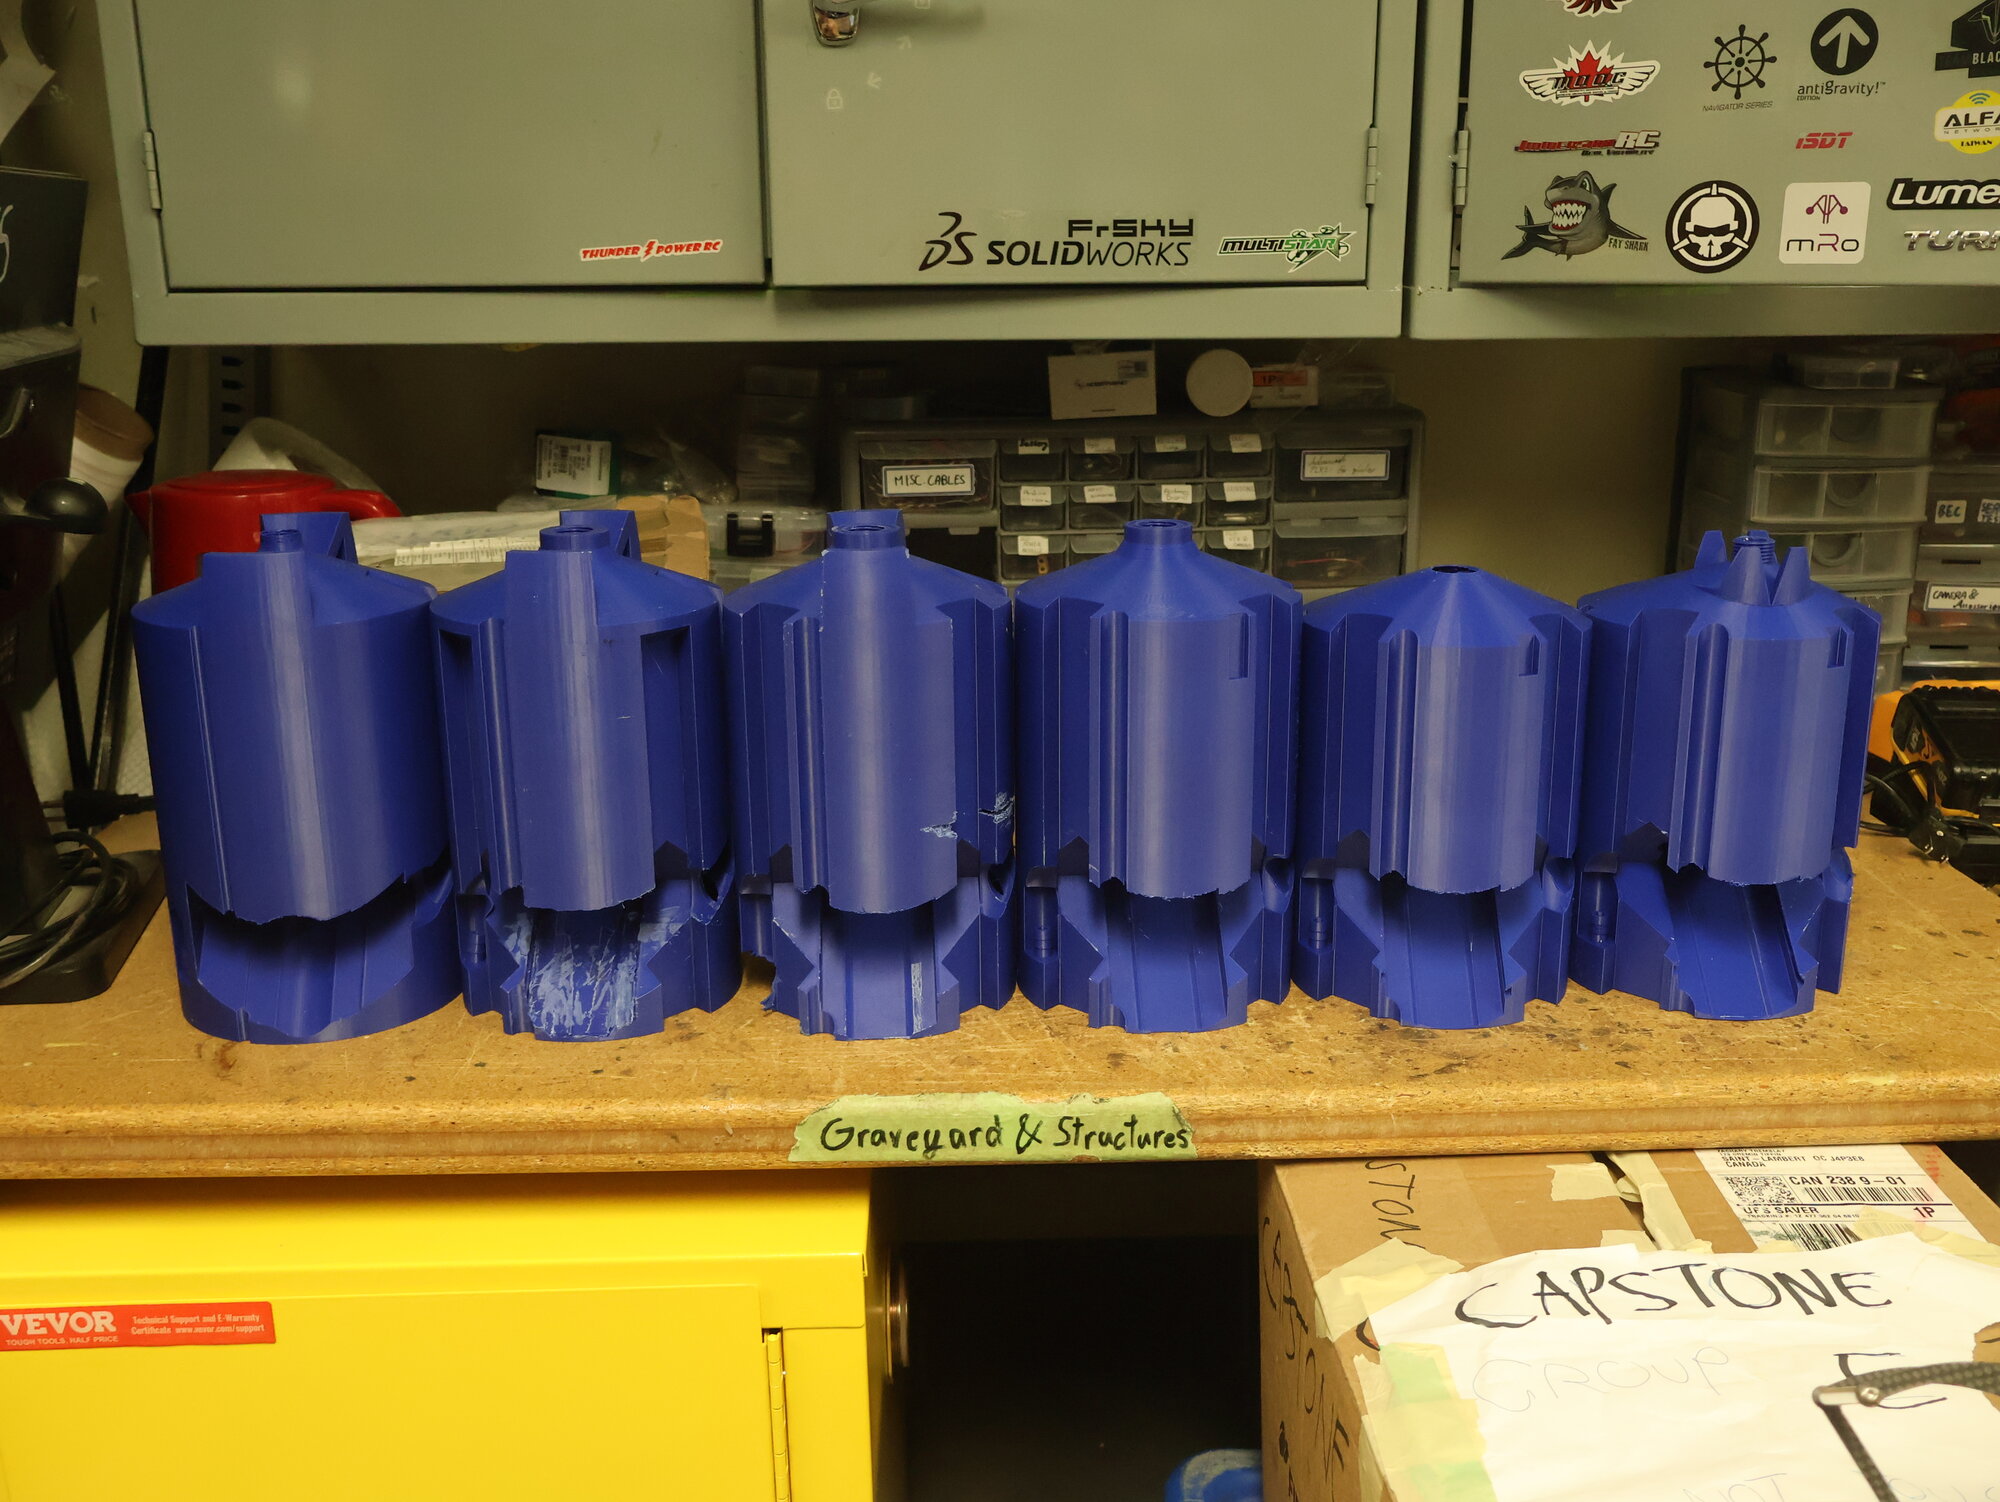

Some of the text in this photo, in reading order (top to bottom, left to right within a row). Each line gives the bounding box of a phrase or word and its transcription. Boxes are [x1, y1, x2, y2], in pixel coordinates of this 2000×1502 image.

[1702, 101, 1773, 112] NAVIGATOR SERIES
[1891, 183, 2000, 205] Lume
[582, 241, 721, 259] THUNDER POWER RC
[1222, 237, 1337, 253] MULTISTAR
[1608, 237, 1649, 252] FAT SHARK
[1786, 233, 1859, 252] mRo
[986, 240, 1192, 267] SOLIDWORKS
[927, 473, 966, 487] CABLES
[1938, 504, 1961, 519] BEC
[1932, 590, 1967, 600] CAMERA
[820, 1113, 1190, 1159] Graveyard & Structures
[1789, 1176, 1823, 1185] CAN
[1826, 1175, 1857, 1185] 238
[1914, 1207, 1936, 1218] 1P
[1454, 1262, 1893, 1329] CAPSTONE
[0, 1311, 117, 1336] VEVOR
[132, 1314, 260, 1325] Technical Support and E-Warranty
[131, 1326, 171, 1335] Certificate
[6, 1338, 36, 1346] TOUGH
[93, 1335, 118, 1343] PRICE
[1472, 1346, 1728, 1412] GROUP
